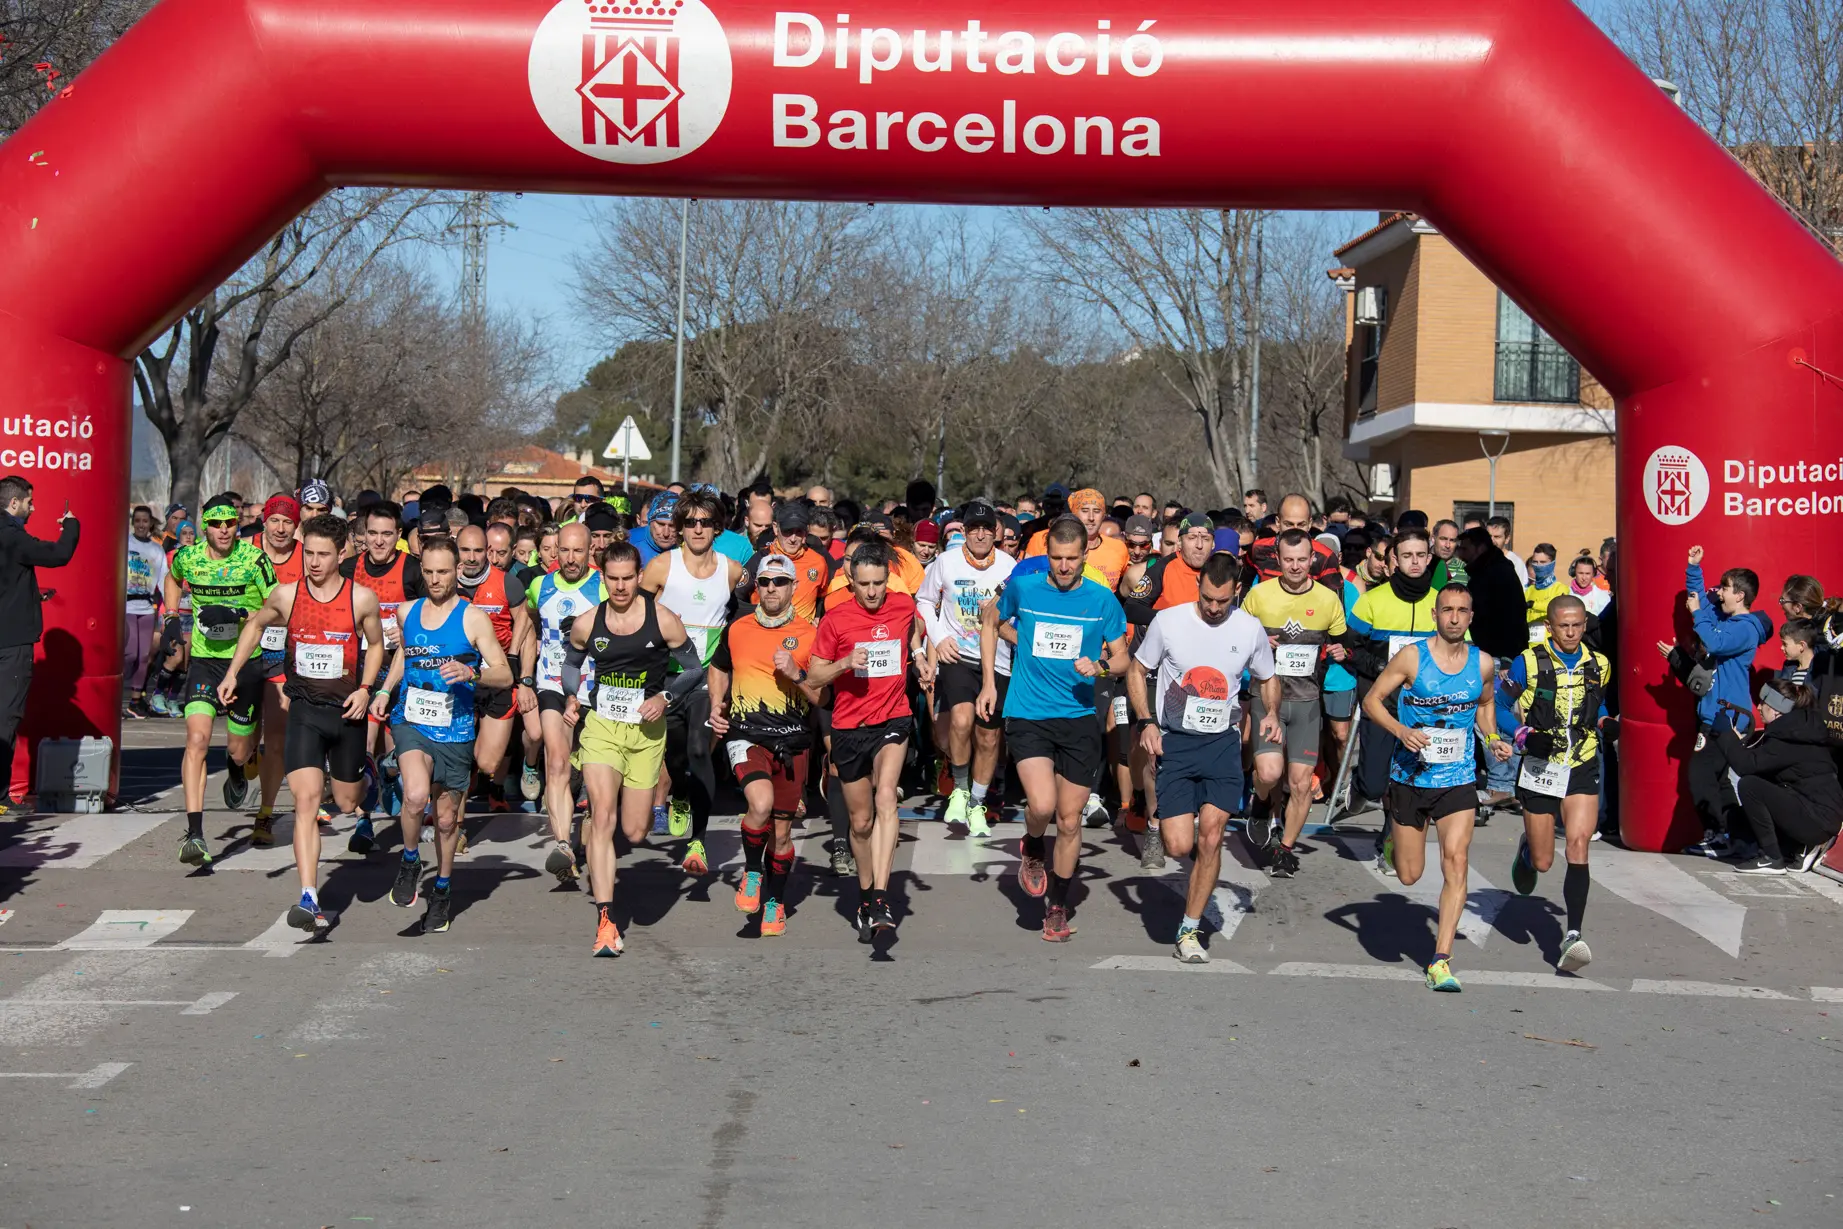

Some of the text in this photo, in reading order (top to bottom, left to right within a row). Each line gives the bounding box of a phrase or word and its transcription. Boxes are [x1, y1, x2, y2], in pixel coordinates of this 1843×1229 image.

[772, 11, 1163, 84] Diputació
[772, 93, 1162, 156] Barcelona
[3, 414, 93, 439] utació
[0, 445, 92, 470] celona
[1724, 457, 1843, 489] Diputaci
[1724, 491, 1843, 516] Barcelon
[1049, 642, 1067, 650] 172
[310, 662, 328, 670] 117
[1413, 691, 1469, 705] CORREDORS
[419, 708, 437, 717] 375
[610, 704, 628, 713] 552
[1199, 715, 1217, 724] 274
[1437, 747, 1454, 755] 381
[1534, 776, 1553, 786] 216
